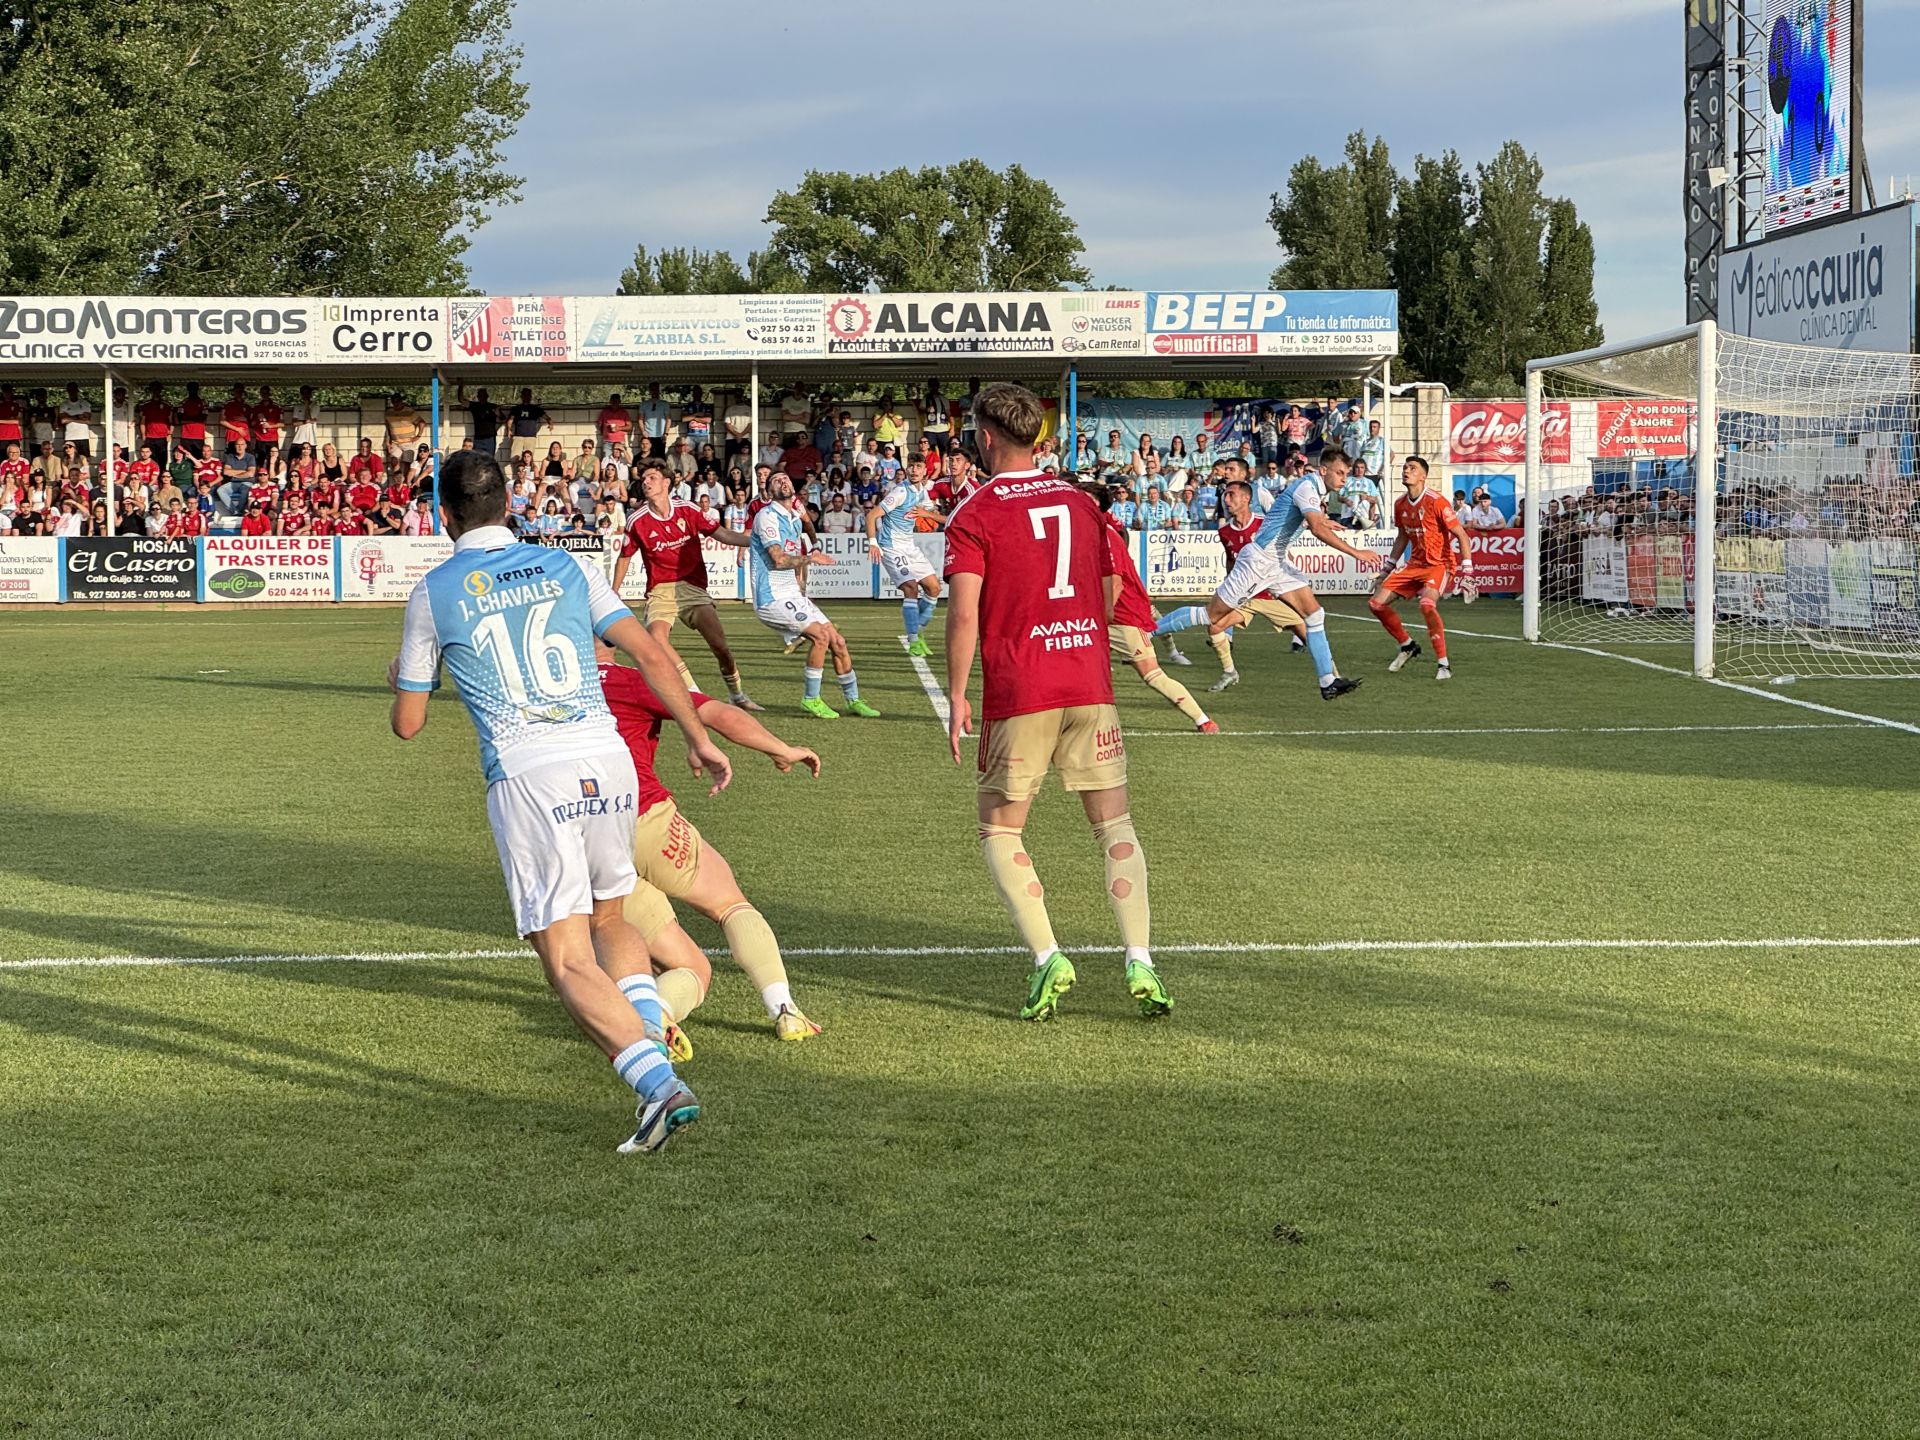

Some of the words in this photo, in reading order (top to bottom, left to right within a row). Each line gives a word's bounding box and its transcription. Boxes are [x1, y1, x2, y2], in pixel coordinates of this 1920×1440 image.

[1690, 73, 1700, 222] CENTRO
[517, 302, 545, 312] PEÑA
[1105, 300, 1141, 308] CLAAS
[343, 305, 439, 325] Imprenta
[783, 307, 821, 315] Empresas
[1152, 294, 1287, 331] BEEP
[501, 316, 562, 325] CAURIENSE
[874, 302, 1052, 333] ALCANA
[1285, 316, 1296, 330] Tu
[1298, 315, 1326, 330] tienda
[1327, 315, 1338, 330] de
[1339, 315, 1392, 329] informática
[616, 319, 740, 330] MULTISERVICIOS
[760, 325, 778, 333] 927
[779, 325, 790, 333] 50
[793, 325, 804, 333] 42
[806, 325, 816, 333] 21
[1801, 312, 1838, 342] CLÍNICA
[1840, 305, 1878, 335] DENTAL
[332, 325, 433, 352] Cerro
[633, 334, 697, 345] ZARBIA
[699, 333, 726, 344] S.L.
[761, 336, 778, 344] 683
[779, 336, 790, 344] 57
[792, 336, 804, 344] 46
[806, 336, 815, 344] 21
[1280, 335, 1296, 344] Tlf.
[1312, 335, 1331, 344] 927
[1333, 335, 1352, 344] 500
[1355, 334, 1373, 343] 533
[832, 342, 890, 352] ALQUILER
[896, 342, 903, 352] Y
[911, 342, 950, 352] VENTA
[955, 342, 971, 351] DE
[978, 341, 1051, 351] MAQUINARIA
[1174, 337, 1252, 352] unofficial
[1377, 344, 1391, 352] Coria
[493, 347, 510, 356] DE
[621, 350, 657, 358] Maquinaria
[721, 348, 750, 356] limpieza
[757, 348, 783, 356] pintura
[795, 347, 824, 355] fachadas
[1637, 406, 1659, 414] POR
[1662, 405, 1698, 414] DONR
[1630, 418, 1674, 427] SANGRE
[1616, 436, 1638, 444] POR
[1641, 435, 1682, 443] SALVAR
[1623, 448, 1655, 456] VIDAS
[206, 539, 300, 550] ALQUILER
[307, 538, 331, 550] DE
[538, 536, 602, 551] RELOJERÍA
[1028, 504, 1075, 599] 7
[104, 551, 195, 572] Casero
[216, 554, 328, 566] TRASTEROS
[894, 555, 908, 568] 20
[1172, 551, 1209, 573] Paniagua
[86, 575, 108, 583] Calle
[109, 575, 132, 584] Guijo
[133, 575, 143, 583] 32
[150, 575, 178, 583] CORIA
[269, 572, 329, 580] ERNESTINA
[496, 566, 546, 583] senpa
[1171, 576, 1184, 584] 699
[1186, 576, 1195, 584] 22
[1197, 576, 1206, 584] 86
[1208, 576, 1217, 584] 25
[1315, 580, 1324, 590] 37
[1326, 580, 1335, 590] 09
[1339, 580, 1347, 590] 10
[1354, 580, 1368, 590] 620
[1496, 576, 1515, 586] 517
[268, 588, 286, 597] 620
[290, 588, 308, 597] 424
[312, 588, 330, 597] 114
[1248, 583, 1257, 594] 4
[89, 591, 103, 599] 927
[105, 591, 120, 599] 500
[175, 590, 191, 598] 404
[459, 601, 475, 623] J.
[476, 577, 565, 614] CHAVALÉS
[786, 601, 797, 612] 9
[1045, 634, 1093, 651] FIBRA
[470, 600, 582, 704] 16
